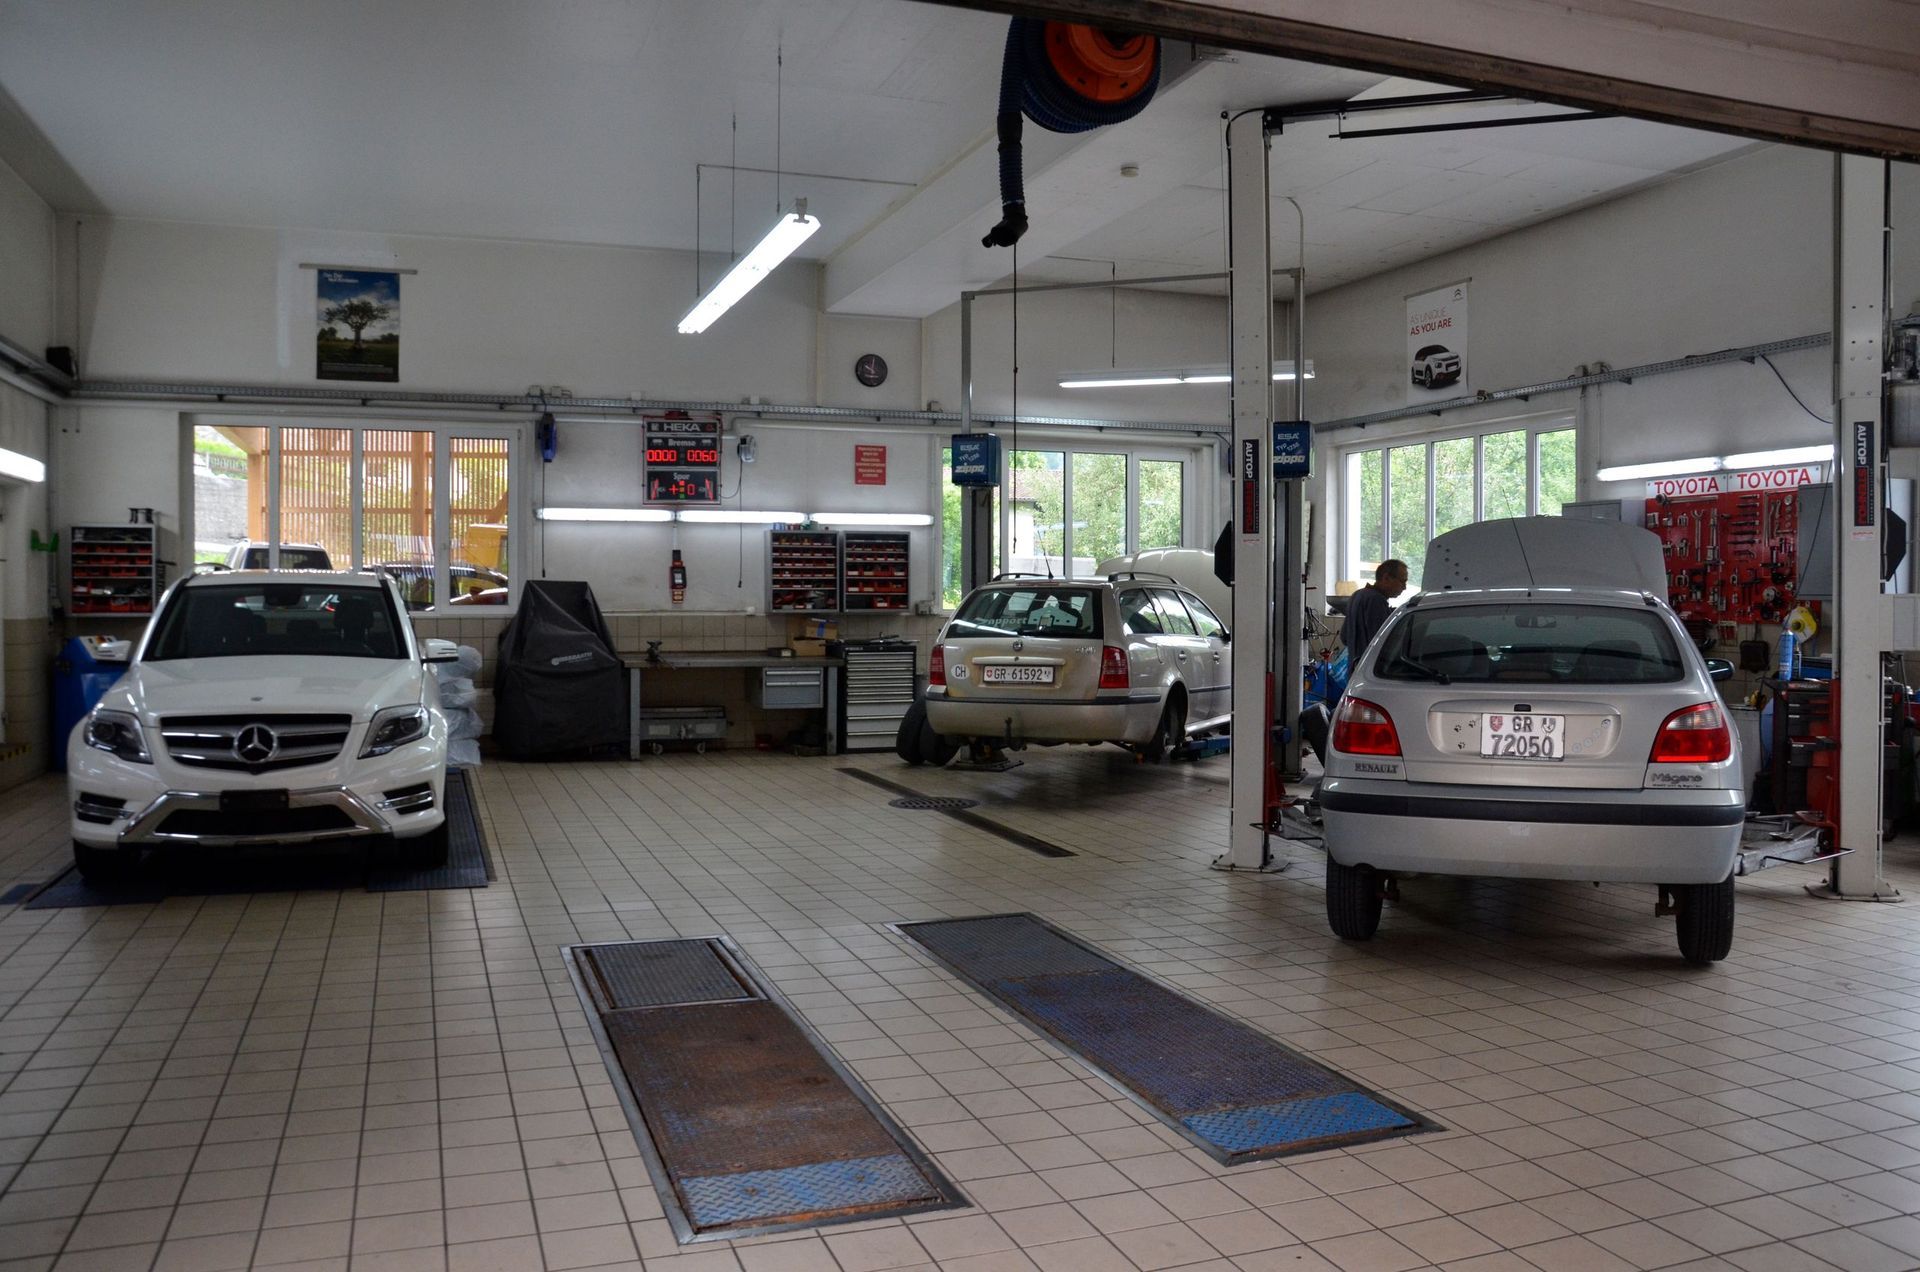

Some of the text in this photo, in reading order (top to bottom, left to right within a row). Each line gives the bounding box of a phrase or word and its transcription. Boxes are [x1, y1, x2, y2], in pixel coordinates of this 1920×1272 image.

[1411, 317, 1453, 336] AS YOU ARE
[663, 423, 701, 432] HEKA
[668, 439, 697, 447] Bremse
[1858, 424, 1867, 465] AUTOP
[647, 450, 718, 462] 0000 0060
[1245, 442, 1253, 479] AUTOP
[1273, 452, 1306, 465] zippo
[955, 462, 985, 474] zippo
[673, 473, 691, 481] Spur
[1736, 468, 1811, 489] TOYOTA
[1654, 476, 1719, 496] TOYOTA
[955, 666, 966, 677] CH
[1512, 716, 1533, 733] GR
[1491, 734, 1555, 758] 72050
[1355, 763, 1399, 774] RENAULT
